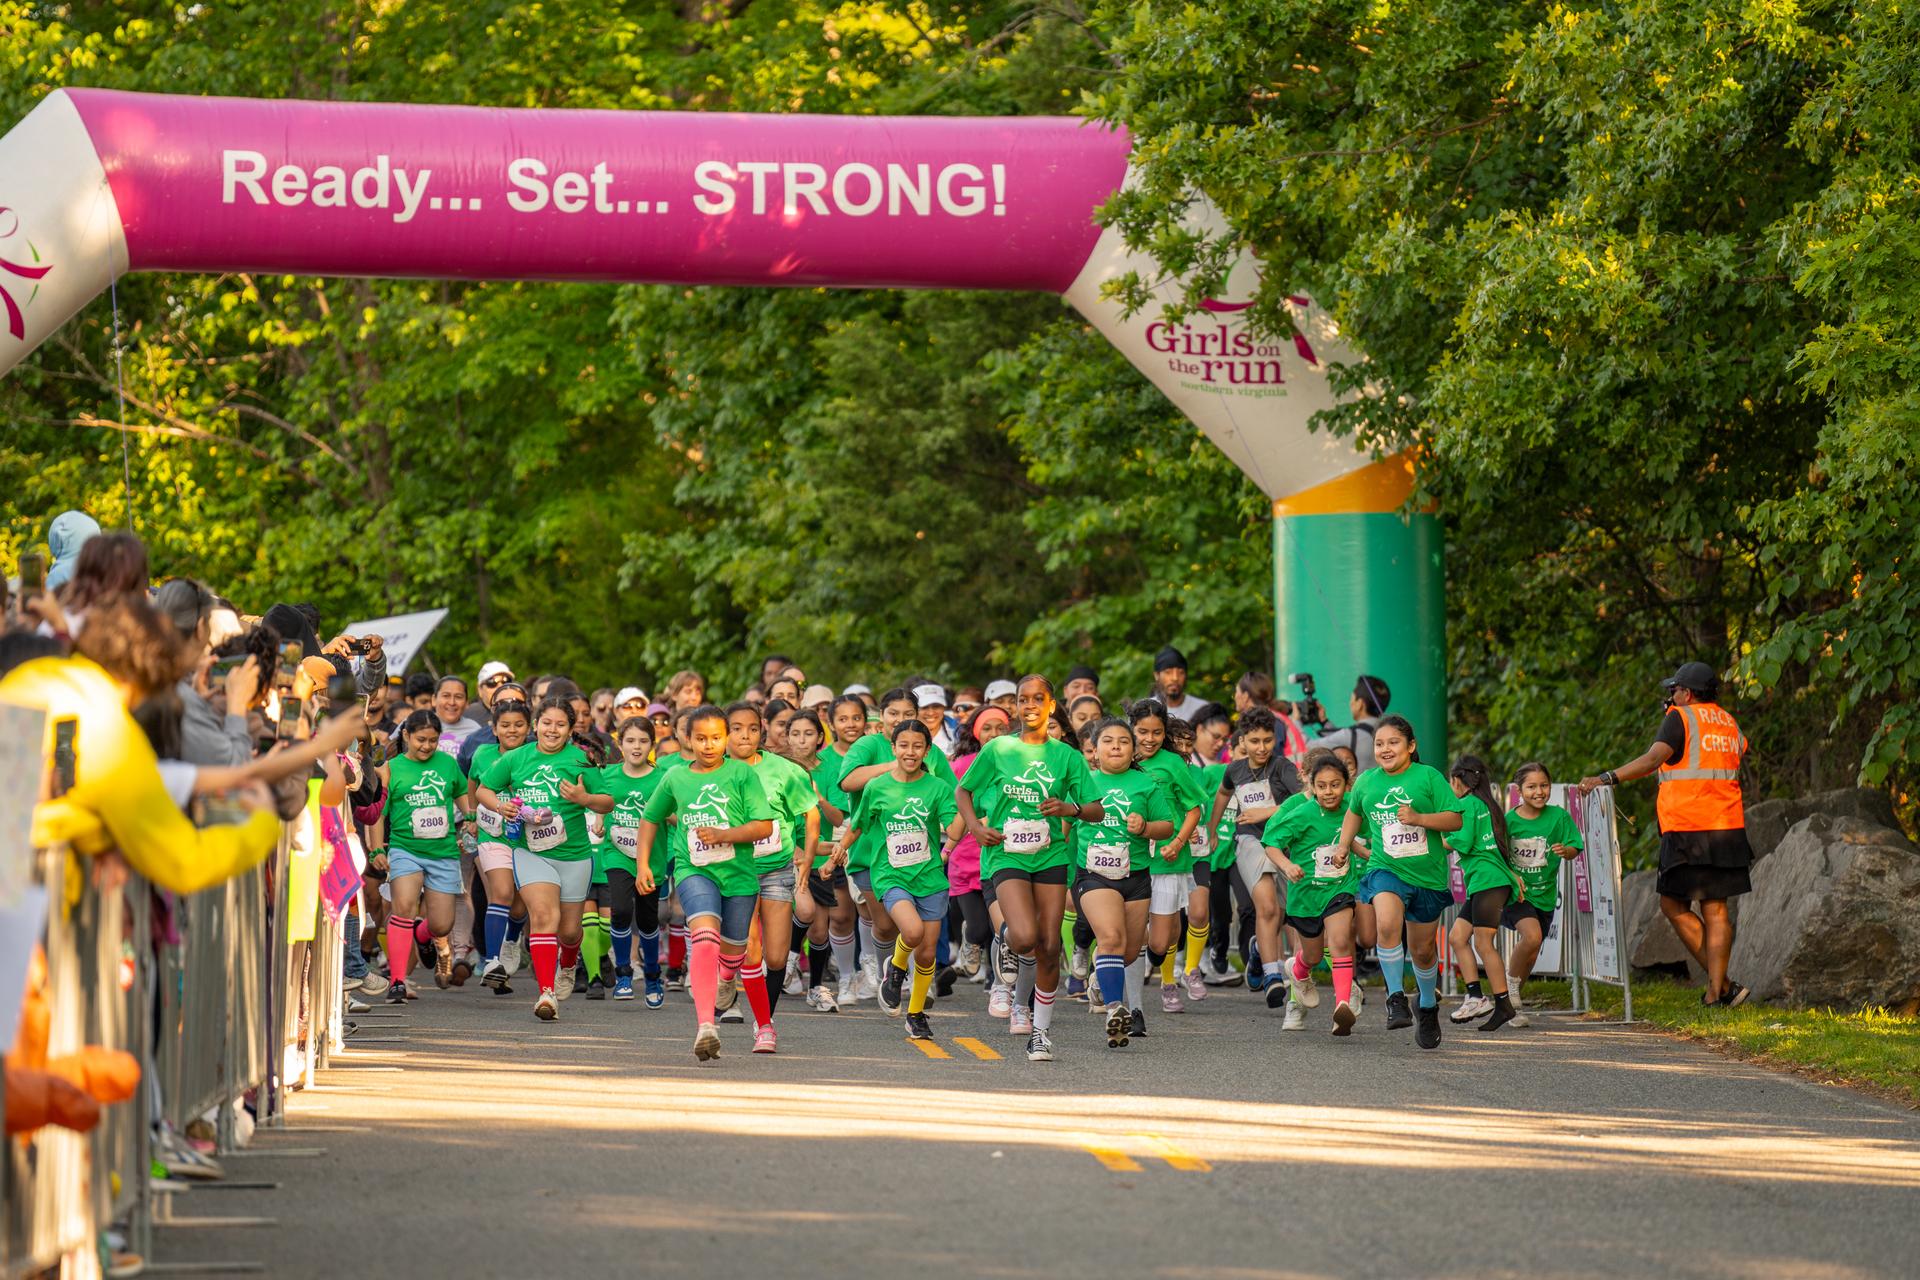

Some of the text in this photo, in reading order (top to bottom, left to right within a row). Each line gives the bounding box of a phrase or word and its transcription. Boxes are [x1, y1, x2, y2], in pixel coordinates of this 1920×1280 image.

[222, 149, 1007, 223] Ready... Set... STRONG!
[1145, 322, 1281, 357] Girls on
[1168, 358, 1286, 384] the run
[1237, 386, 1288, 399] virginia
[1698, 708, 1735, 728] RACE
[1003, 784, 1032, 795] Girls
[404, 791, 430, 803] Girls
[1017, 795, 1040, 803] run
[1243, 792, 1265, 804] 4509
[420, 817, 444, 828] 2808
[682, 811, 709, 825] Girls
[886, 821, 913, 831] Girls
[532, 826, 558, 840] 2800
[1012, 832, 1042, 843] 2825
[1391, 832, 1419, 845] 2799
[617, 836, 637, 847] 280
[895, 842, 922, 855] 2802
[1514, 847, 1537, 858] 2421
[1094, 856, 1121, 867] 2823
